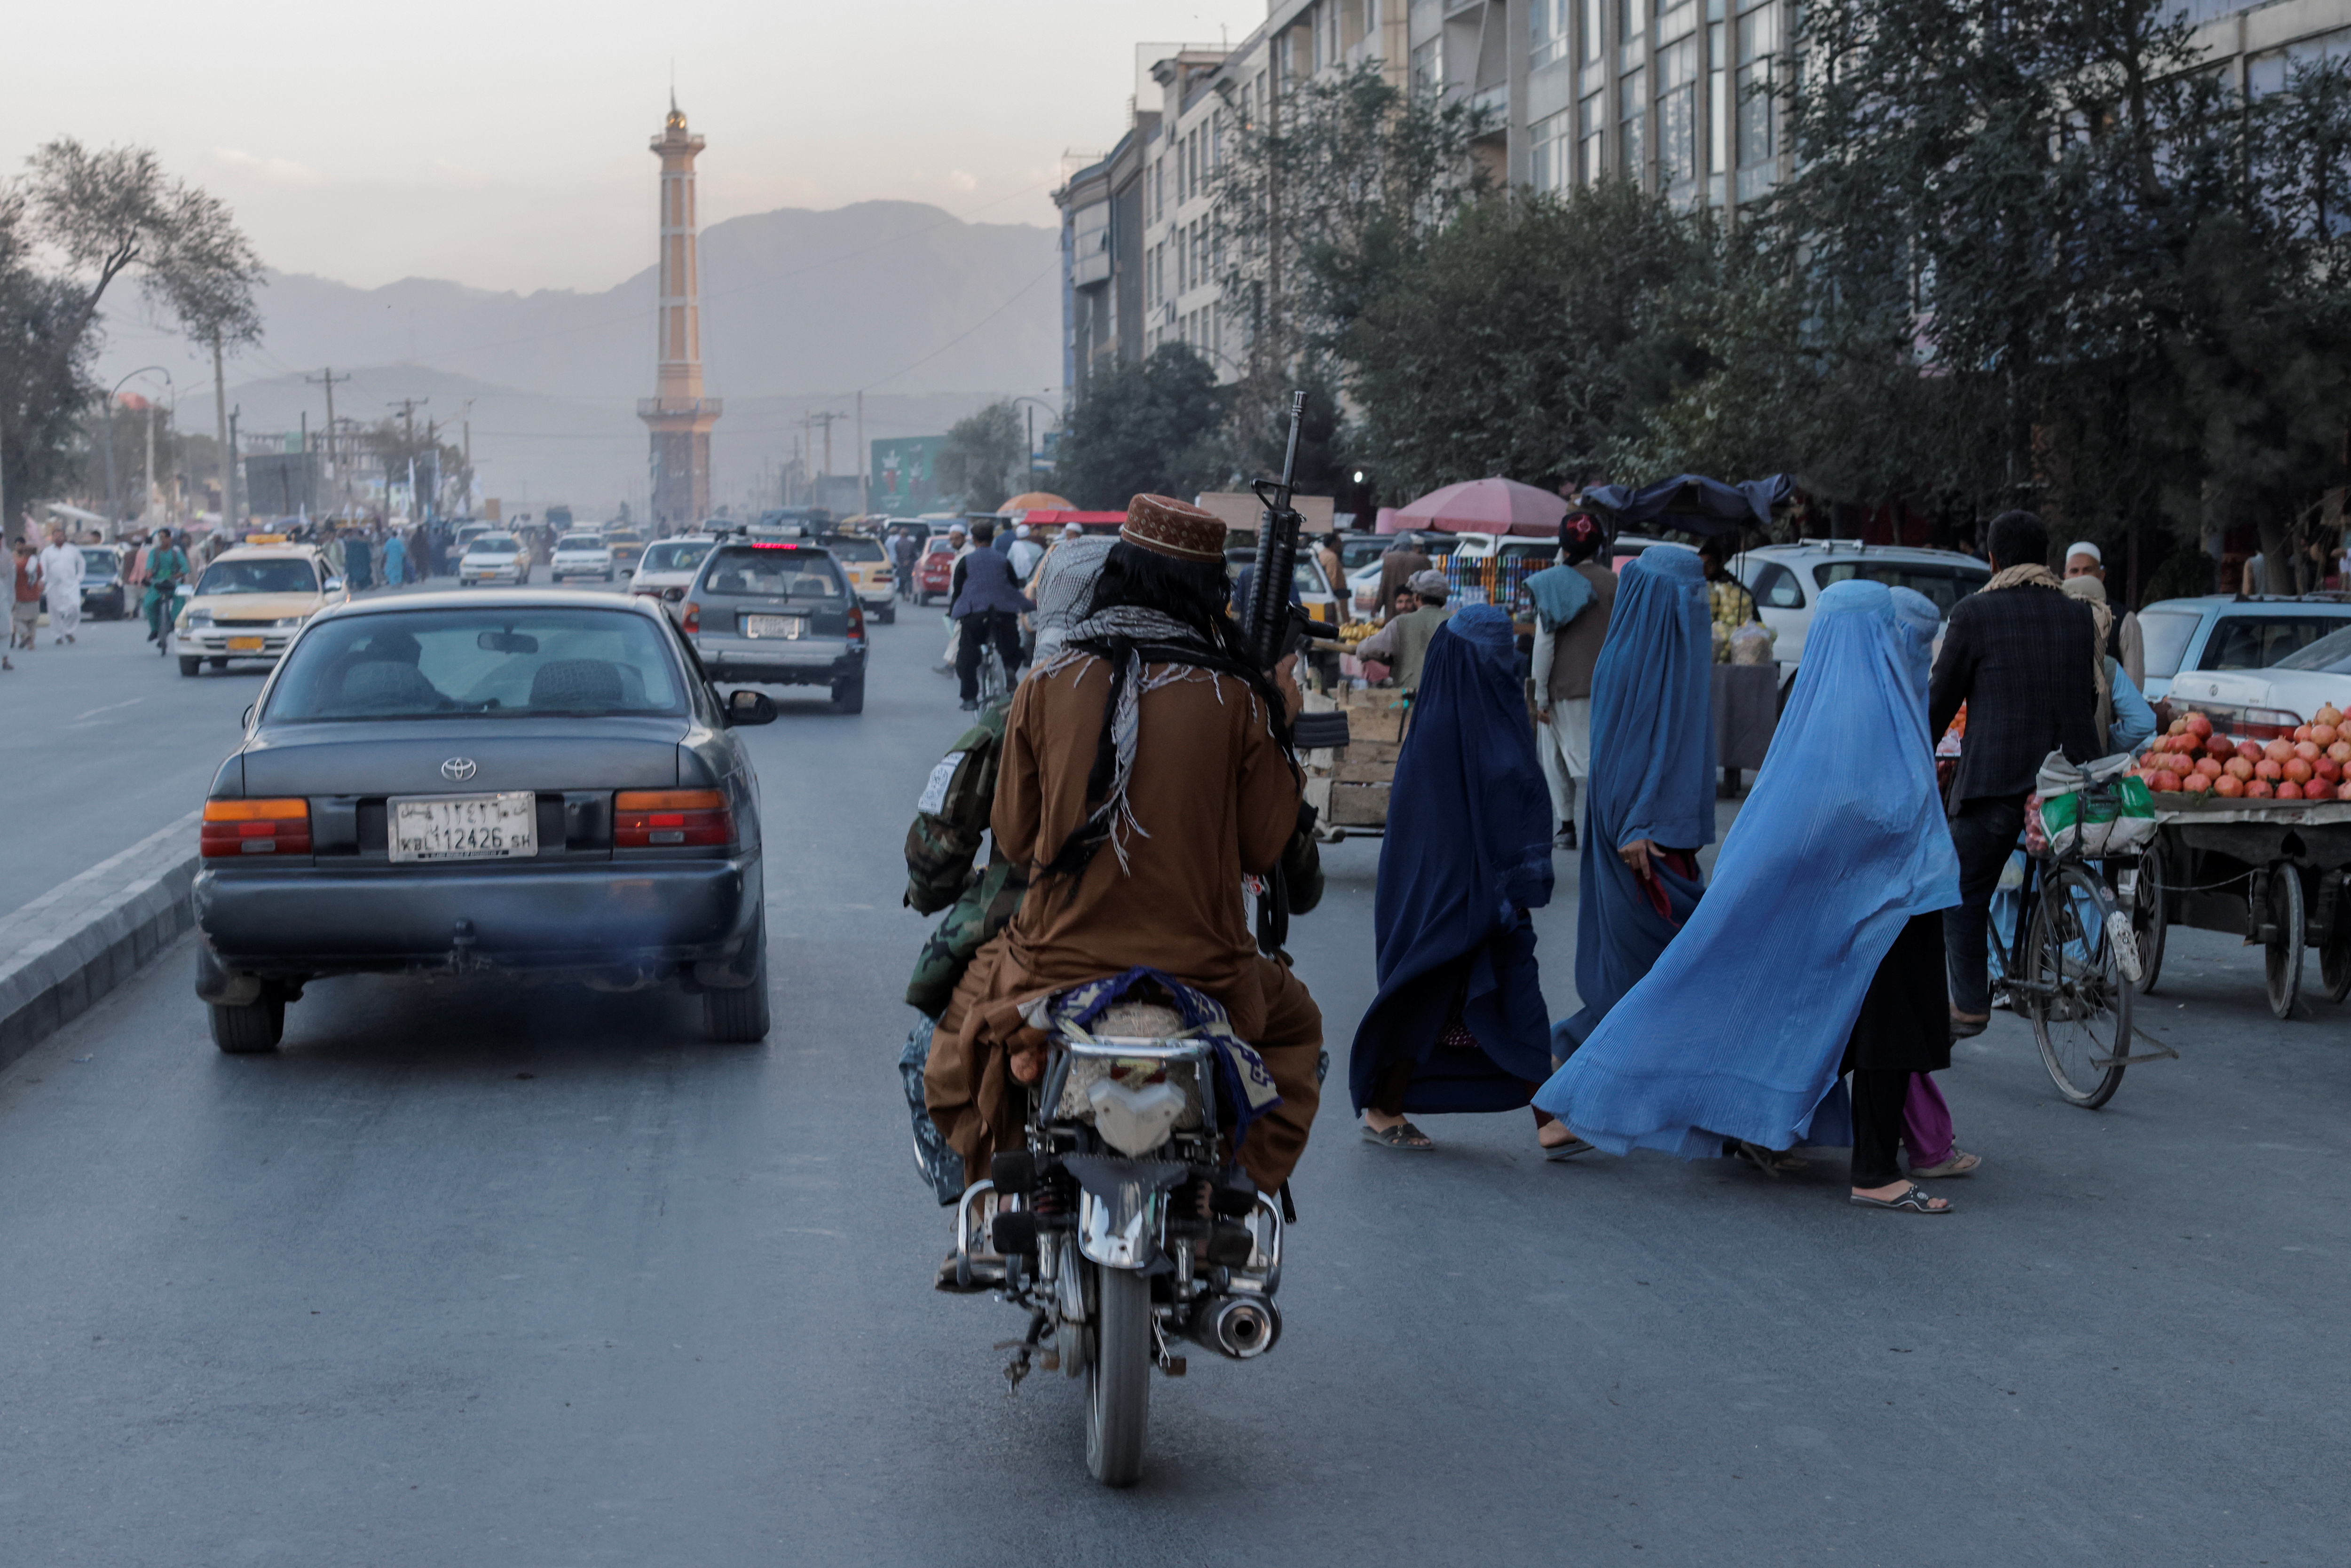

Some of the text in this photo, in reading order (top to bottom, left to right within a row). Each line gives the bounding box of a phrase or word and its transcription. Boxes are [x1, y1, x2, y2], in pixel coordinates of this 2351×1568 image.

[401, 835, 433, 851] KBL
[444, 827, 502, 850] 12426
[512, 834, 530, 848] SH
